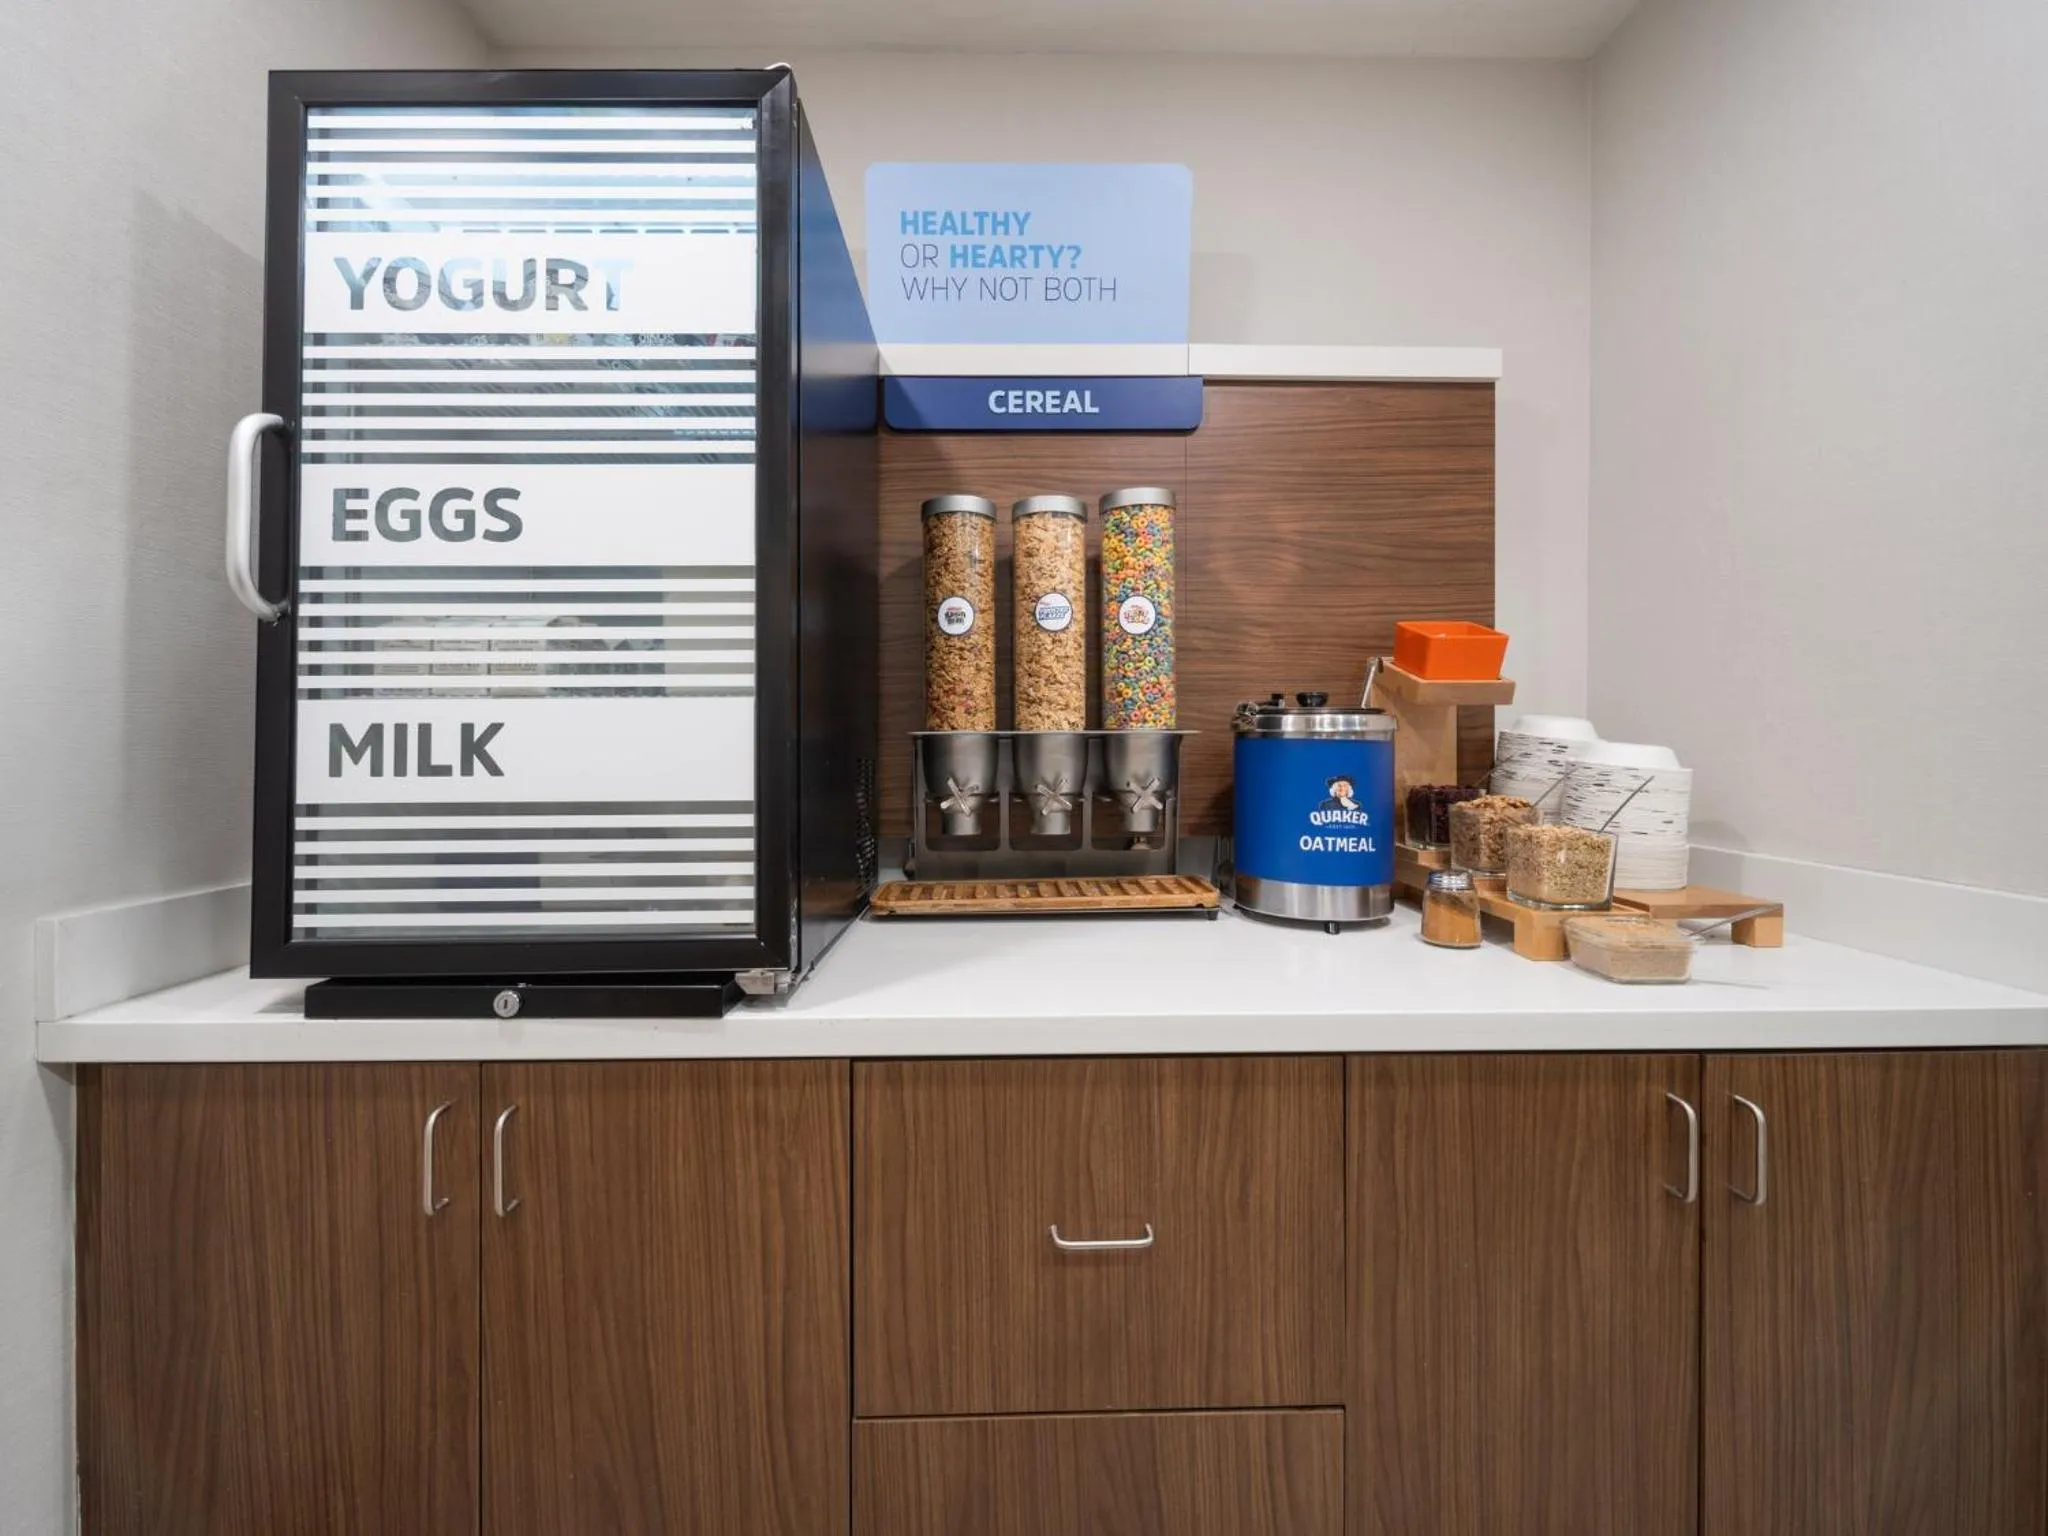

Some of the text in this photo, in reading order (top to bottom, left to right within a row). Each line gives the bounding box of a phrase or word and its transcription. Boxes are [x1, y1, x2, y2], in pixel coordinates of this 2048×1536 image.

[900, 211, 1030, 235] HEALTHY
[901, 243, 1081, 268] OR HEARTY?
[334, 257, 633, 312] YOGURT
[901, 276, 1116, 301] WHY NOT BOTH
[989, 391, 1099, 413] CEREAL
[332, 488, 522, 542] EGGS
[329, 723, 504, 777] MILK
[1310, 810, 1368, 825] QUAKER
[1300, 836, 1375, 852] OATMEAL
